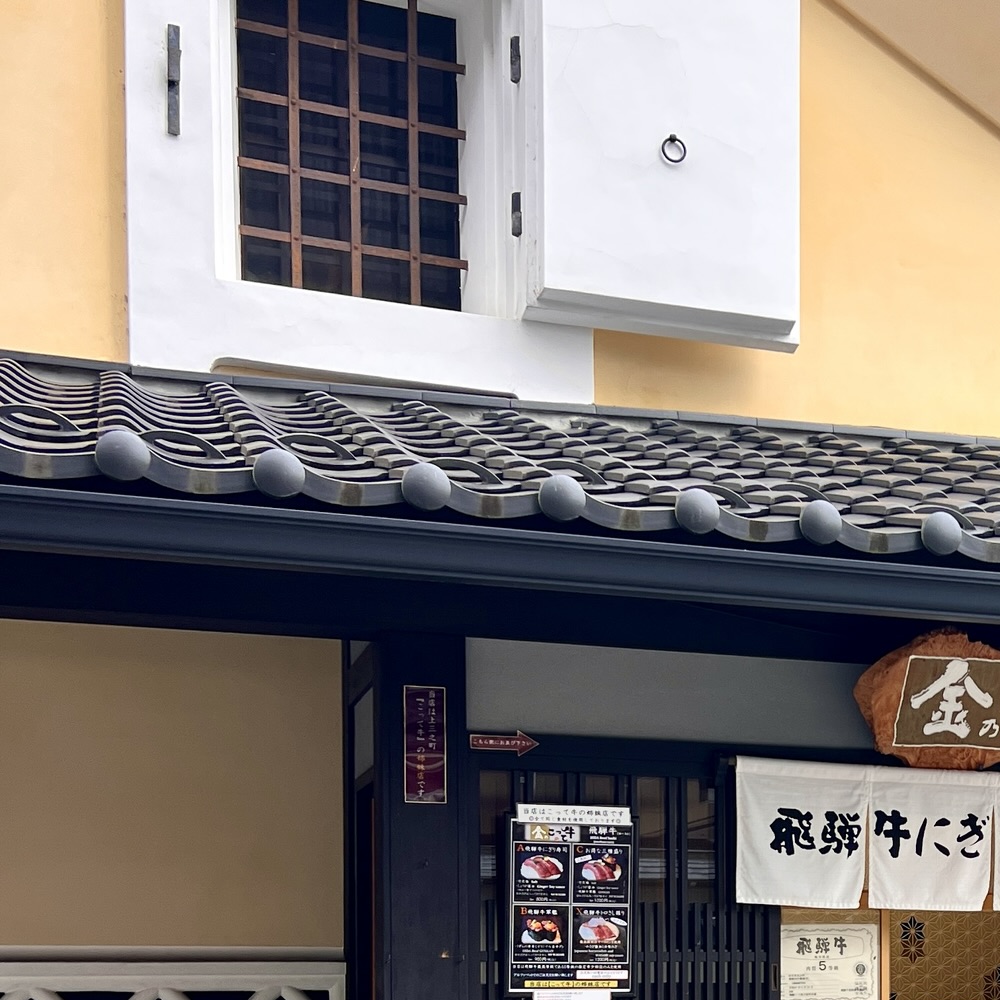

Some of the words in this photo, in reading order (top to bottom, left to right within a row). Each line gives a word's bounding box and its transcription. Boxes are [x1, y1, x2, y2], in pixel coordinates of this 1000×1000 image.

[523, 808, 625, 817] 当店はこって牛の姉妹店です
[516, 844, 524, 852] A
[520, 907, 527, 915] B
[795, 936, 847, 955] 飛騨牛
